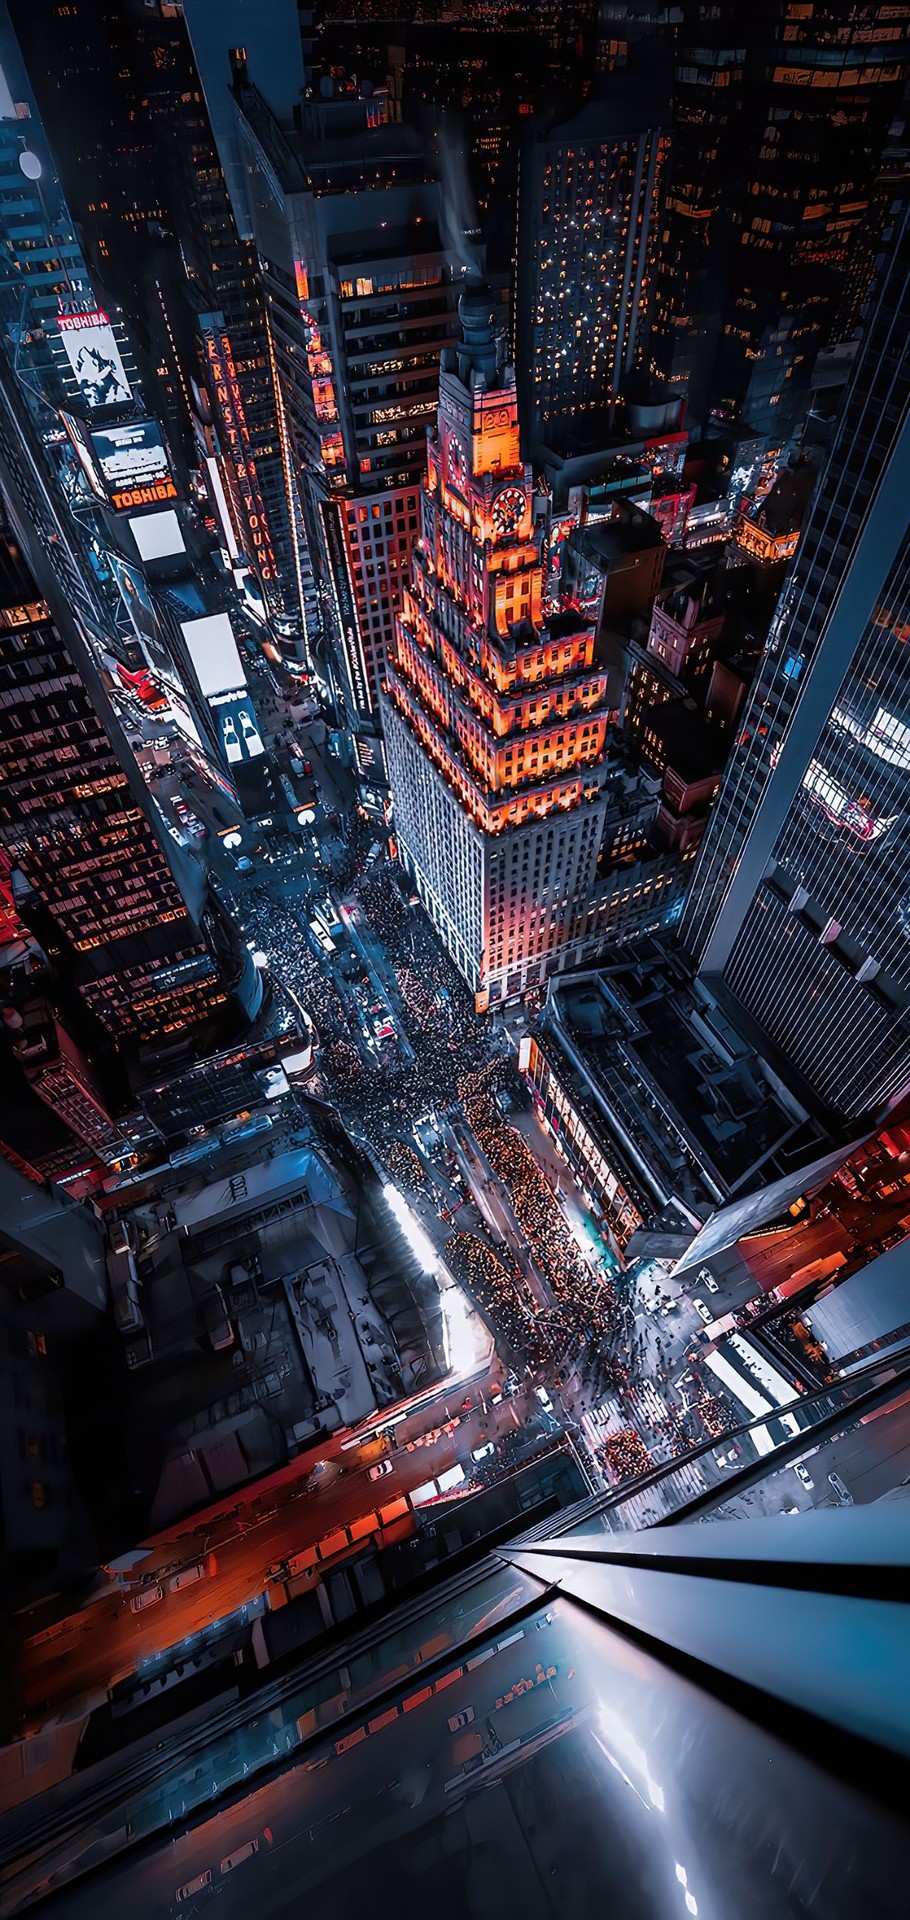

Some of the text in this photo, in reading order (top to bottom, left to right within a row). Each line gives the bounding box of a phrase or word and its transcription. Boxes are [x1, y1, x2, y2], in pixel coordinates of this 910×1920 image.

[111, 483, 178, 508] TOSHIBA
[206, 340, 237, 444] ERNST
[244, 495, 271, 579] YOUNG
